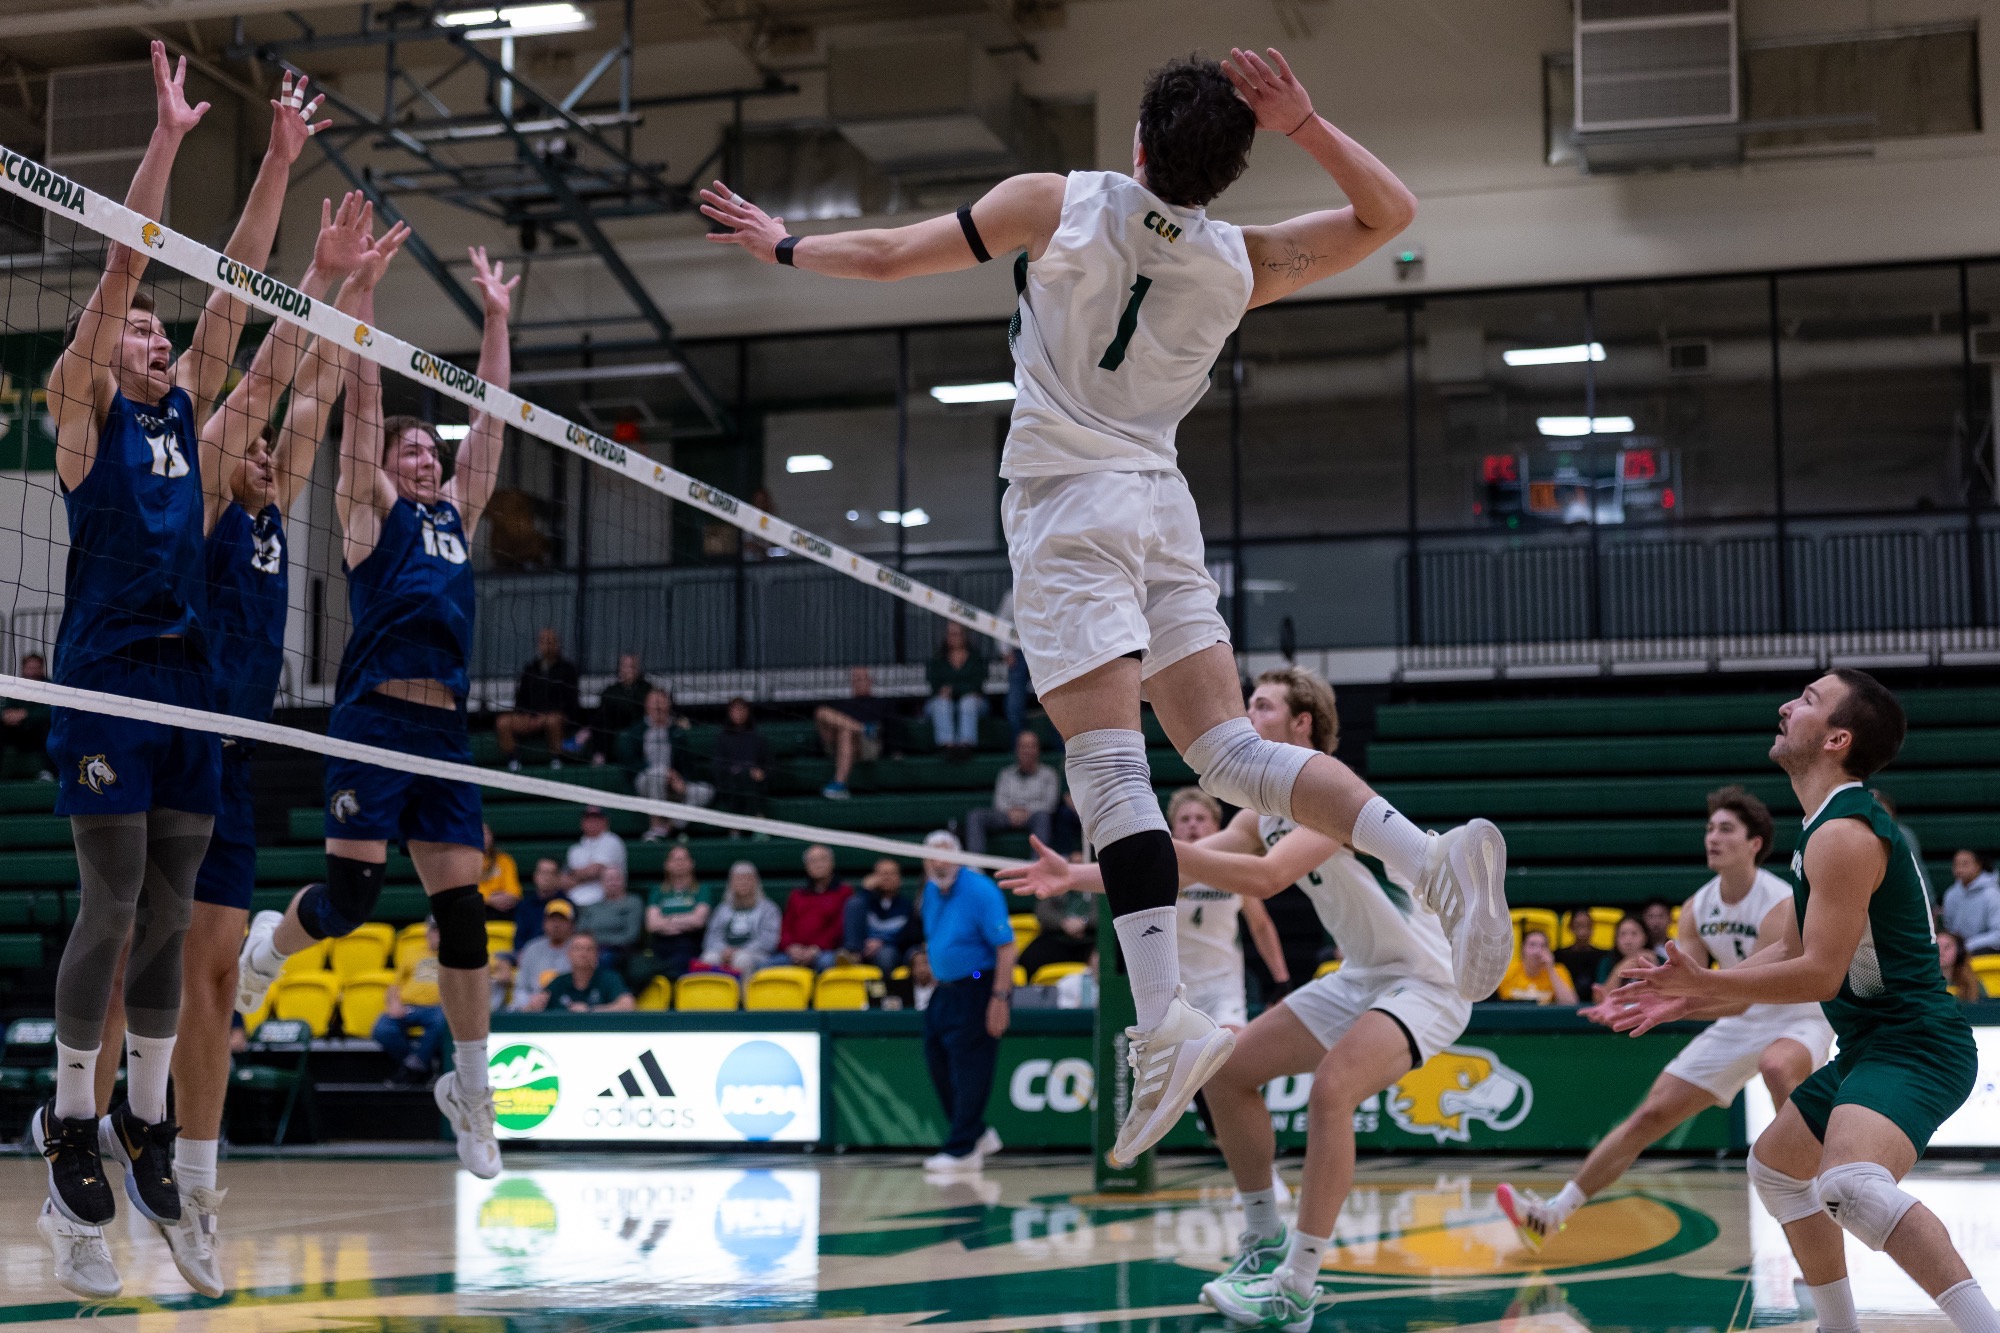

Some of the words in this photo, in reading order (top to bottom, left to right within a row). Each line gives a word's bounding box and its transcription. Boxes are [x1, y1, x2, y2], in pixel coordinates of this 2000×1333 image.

[217, 256, 312, 321] CONCORDIA
[1098, 274, 1153, 372] 1
[411, 350, 487, 402] CONCORDIA
[566, 424, 627, 467] CONCORDIA
[422, 520, 468, 565] 10
[1190, 906, 1203, 928] 4
[583, 1098, 694, 1129] adidas
